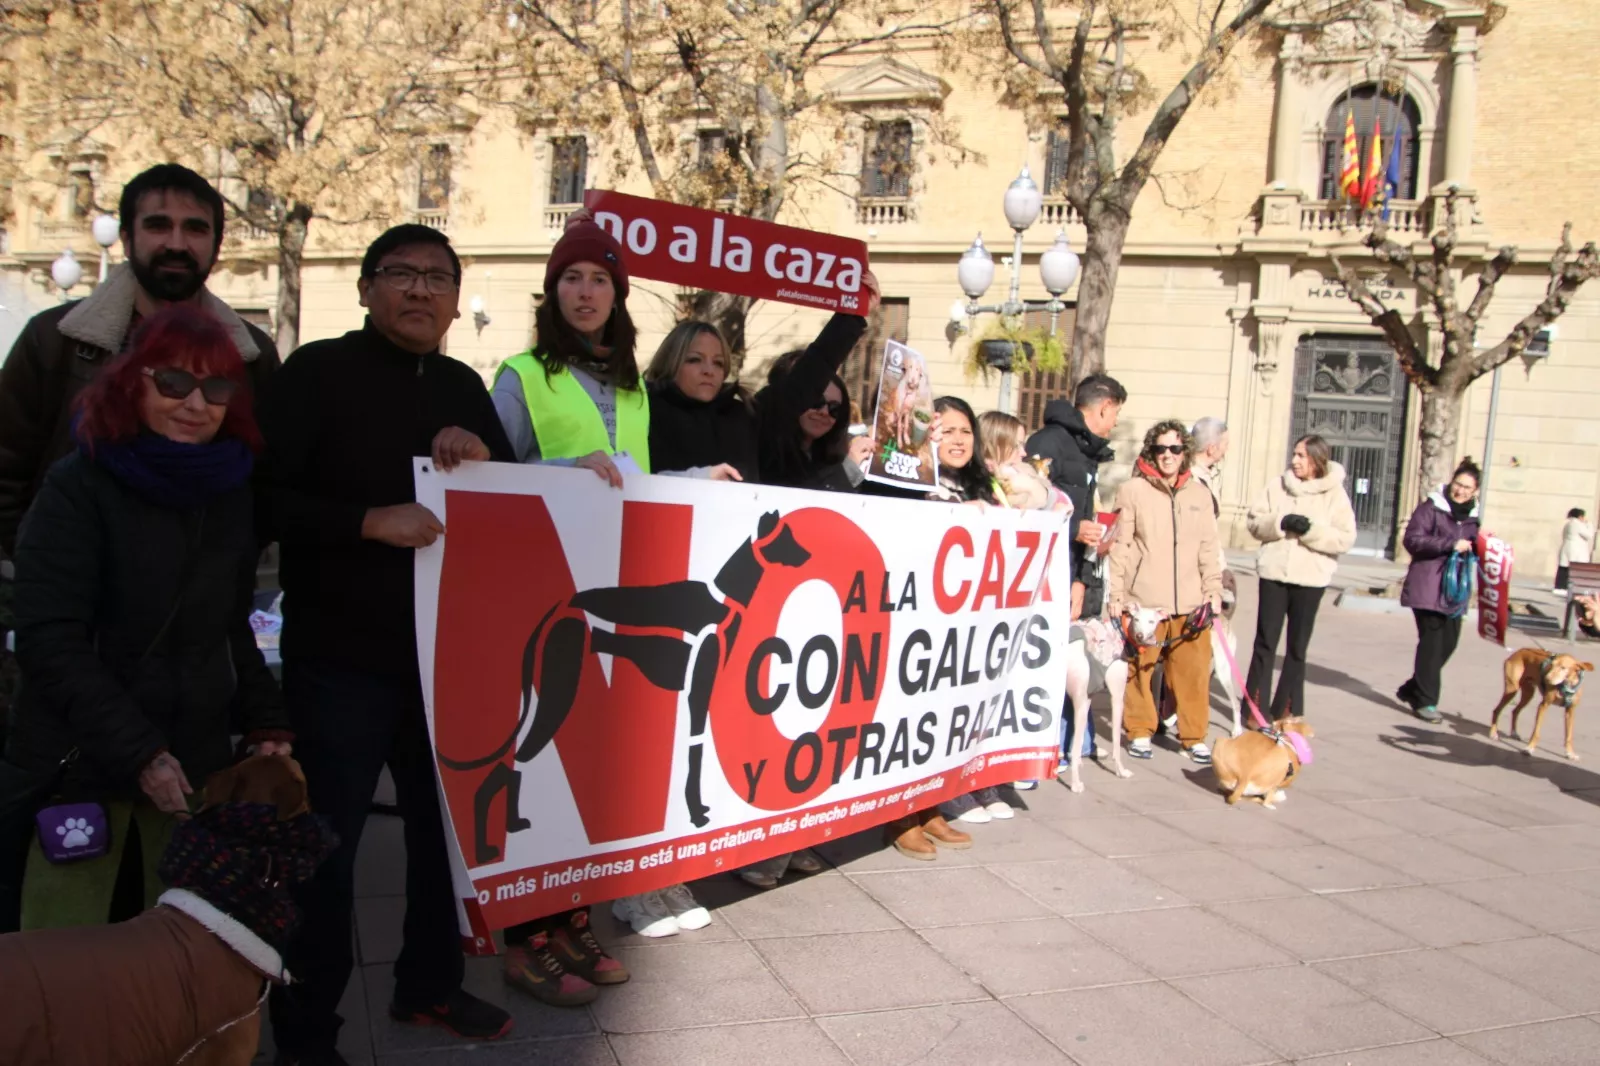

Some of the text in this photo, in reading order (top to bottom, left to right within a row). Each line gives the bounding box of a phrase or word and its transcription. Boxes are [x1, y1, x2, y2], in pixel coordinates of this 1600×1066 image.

[594, 211, 863, 293] no a la caza
[884, 460, 919, 480] CAZA
[843, 570, 867, 614] A
[879, 571, 918, 612] LA
[1480, 587, 1499, 607] la
[1482, 537, 1504, 585] caza
[433, 489, 892, 870] NO
[745, 614, 1051, 716] CON GALGOS
[784, 711, 938, 794] OTRAS
[945, 686, 1053, 757] RAZAS
[496, 875, 537, 901] más
[542, 858, 634, 889] indefensa
[639, 847, 673, 870] está
[677, 840, 706, 859] una
[709, 823, 767, 852] criatura,
[768, 817, 798, 837] más
[799, 806, 848, 829] derecho
[850, 800, 877, 816] tiene
[877, 797, 884, 808] a
[885, 792, 902, 804] ser
[902, 776, 945, 801] defendida
